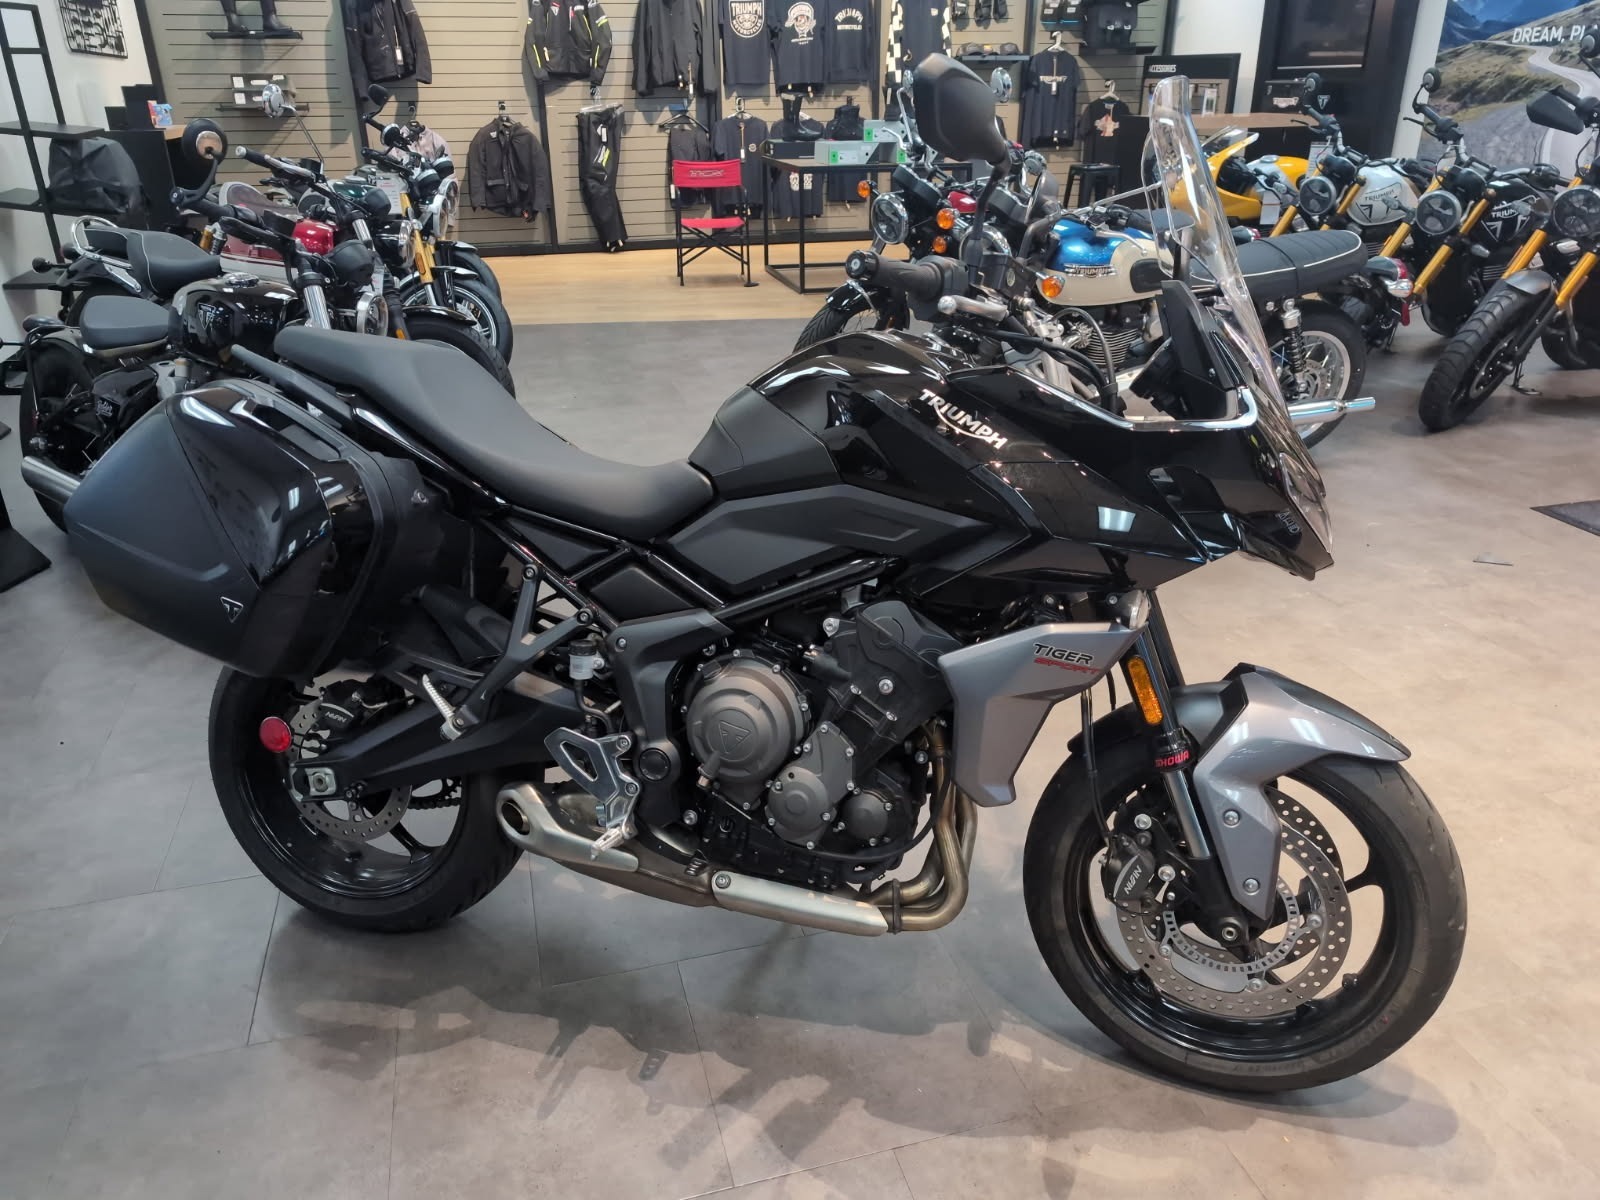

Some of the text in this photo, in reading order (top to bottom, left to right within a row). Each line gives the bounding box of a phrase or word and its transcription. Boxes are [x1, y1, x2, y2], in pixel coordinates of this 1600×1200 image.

[731, 2, 762, 16] TRIUMPH
[919, 388, 1008, 450] TRIUMPH
[1033, 642, 1094, 666] TIGER
[1154, 749, 1190, 768] SHOWA
